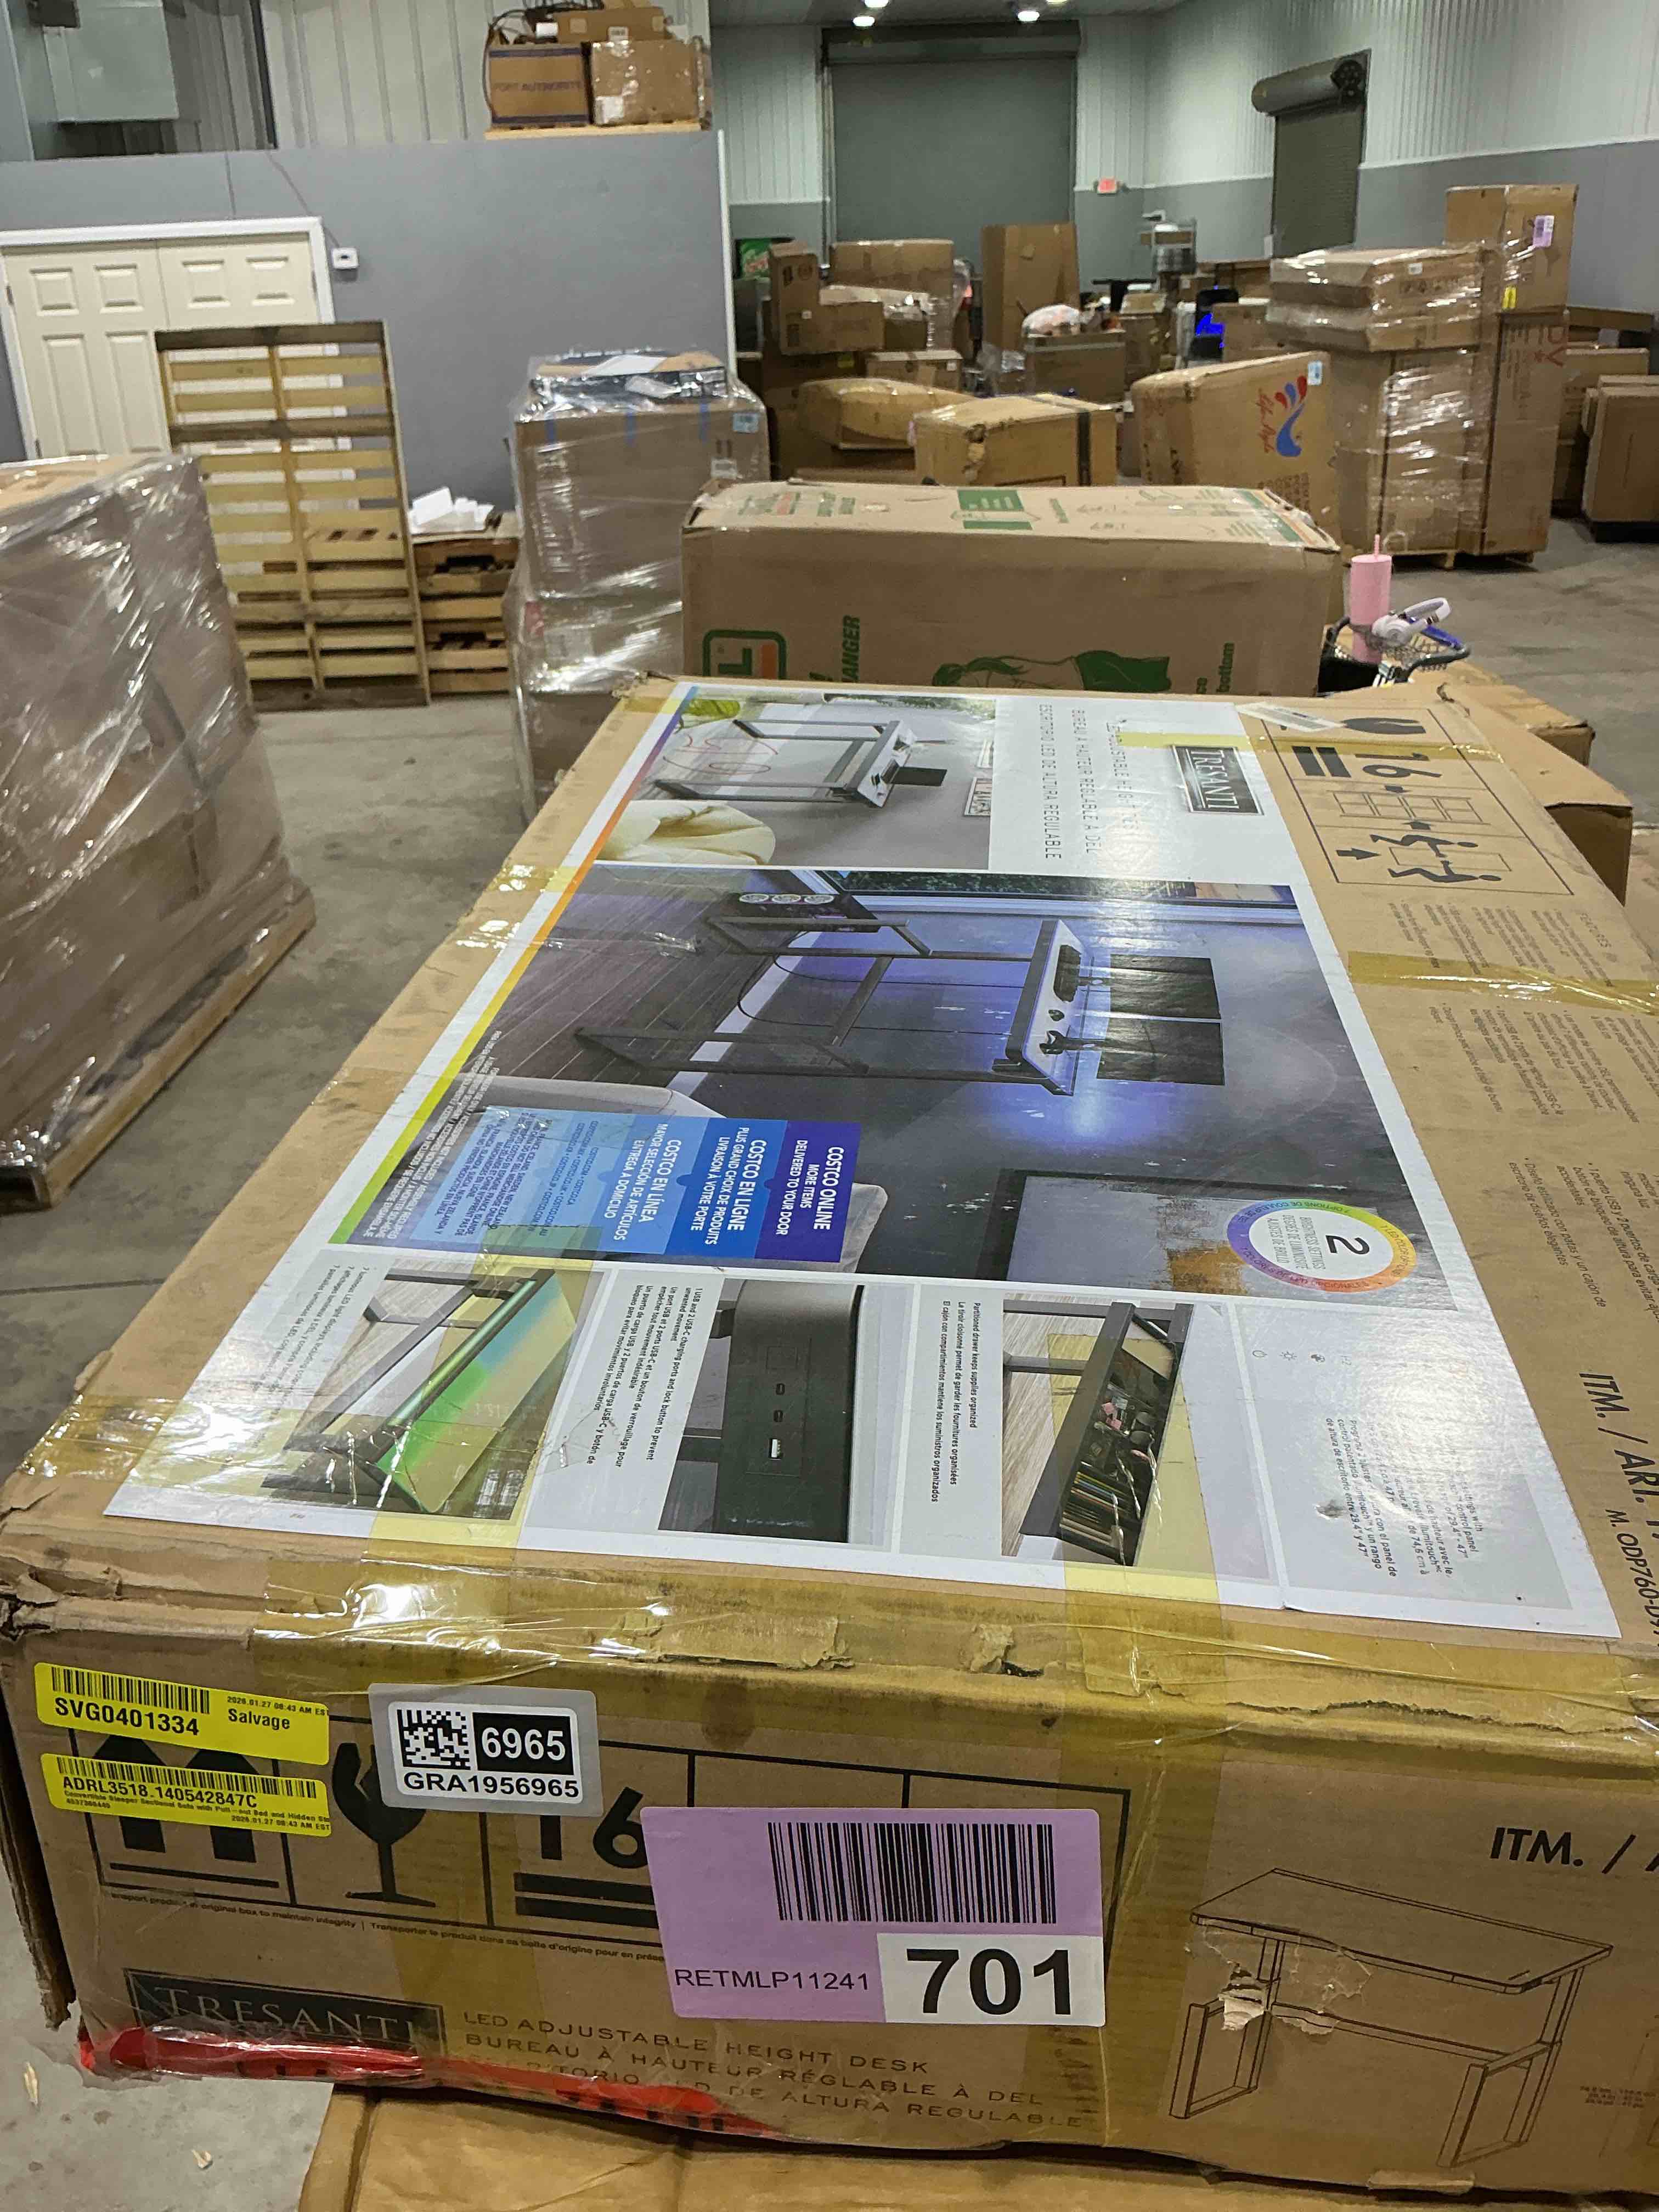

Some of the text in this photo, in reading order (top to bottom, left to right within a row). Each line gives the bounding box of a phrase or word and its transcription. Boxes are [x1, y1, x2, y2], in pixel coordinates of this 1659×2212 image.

[842, 616, 860, 683] ANGER
[1042, 772, 1058, 799] ALTURA
[1193, 749, 1241, 811] TRESANTI
[1045, 804, 1062, 859] REGULABLE
[1085, 834, 1102, 854] DEL
[622, 1140, 644, 1171] ENTREGA
[709, 1137, 730, 1172] LIVRAISON
[614, 1124, 668, 1240] MAYOR SELECCIÓN DE ARTÍCULOS
[638, 1139, 682, 1222] COSTCO EN LÍNEA
[699, 1181, 716, 1204] VOTRE
[706, 1127, 749, 1244] PLUS GRAND CHOIX DE PRODUITS
[727, 1139, 767, 1231] COSTCO EN LIGNE
[777, 1139, 808, 1235] DELIVERED TO YOUR DOOR
[799, 1164, 819, 1208] MORE ITEMS
[814, 1146, 844, 1229] COSTCO ONLINE
[604, 1180, 629, 1218] DOMICILIO
[691, 1206, 709, 1230] PORTE
[1299, 1216, 1327, 1269] BRIGHTNESS SETTINGS
[1326, 1234, 1370, 1256] 2
[1553, 1218, 1567, 1232] con
[1560, 1233, 1579, 1254] patas
[1576, 1261, 1588, 1272] un
[1593, 1296, 1607, 1307] de
[1613, 1235, 1651, 1304] altura para evitar
[637, 1294, 651, 1310] puerto
[690, 1303, 699, 1313] and
[693, 1291, 702, 1302] USB
[629, 1319, 640, 1334] carga
[672, 1287, 691, 1341] unwanted movement
[683, 1318, 695, 1336] USB-C
[941, 1307, 950, 1321] cajón
[627, 1335, 636, 1346] USB
[675, 1336, 690, 1360] charging
[614, 1357, 629, 1379] puertos
[670, 1362, 682, 1377] ports
[938, 1333, 949, 1380] compartimientos
[971, 1353, 979, 1370] keeps
[664, 1391, 674, 1403] lock
[668, 1378, 678, 1389] and
[970, 1371, 979, 1395] supplies
[1578, 1373, 1630, 1418] ITM.
[605, 1390, 617, 1406] carga
[969, 1397, 978, 1427] organized
[600, 1408, 613, 1427] USB-C
[658, 1404, 670, 1425] button
[591, 1435, 603, 1454] botón
[646, 1435, 662, 1460] prevent
[935, 1422, 943, 1458] suministros
[1597, 1426, 1649, 1444] /
[588, 1455, 597, 1464] de
[1328, 1427, 1339, 1446] altura
[1336, 1458, 1351, 1491] escritorio
[1345, 1493, 1356, 1510] entre
[930, 1460, 941, 1502] organizados
[1605, 1509, 1630, 1527] M.
[1438, 1547, 1448, 1564] avec
[55, 1697, 199, 1736] SVG0401334
[228, 1708, 290, 1730] Salvage
[315, 1708, 330, 1717] EST
[482, 1727, 566, 1761] 6965
[64, 1776, 257, 1808] ADRL3518.140542847C
[404, 1772, 579, 1798] GRA1956965
[1490, 1827, 1584, 1867] ITM.
[1601, 1833, 1637, 1875] /
[675, 1969, 868, 1991] RETMLP11241
[906, 1948, 1071, 2017] 701
[155, 1986, 414, 2043] TRESANTI
[464, 2010, 928, 2074] LED ADJUSTABLE HEIGHT DESK
[466, 2033, 1042, 2106] BUREAU À HAUTEUR RÉGLABLE À DEL
[729, 2084, 1082, 2128] DE ALTURA REGULABLE
